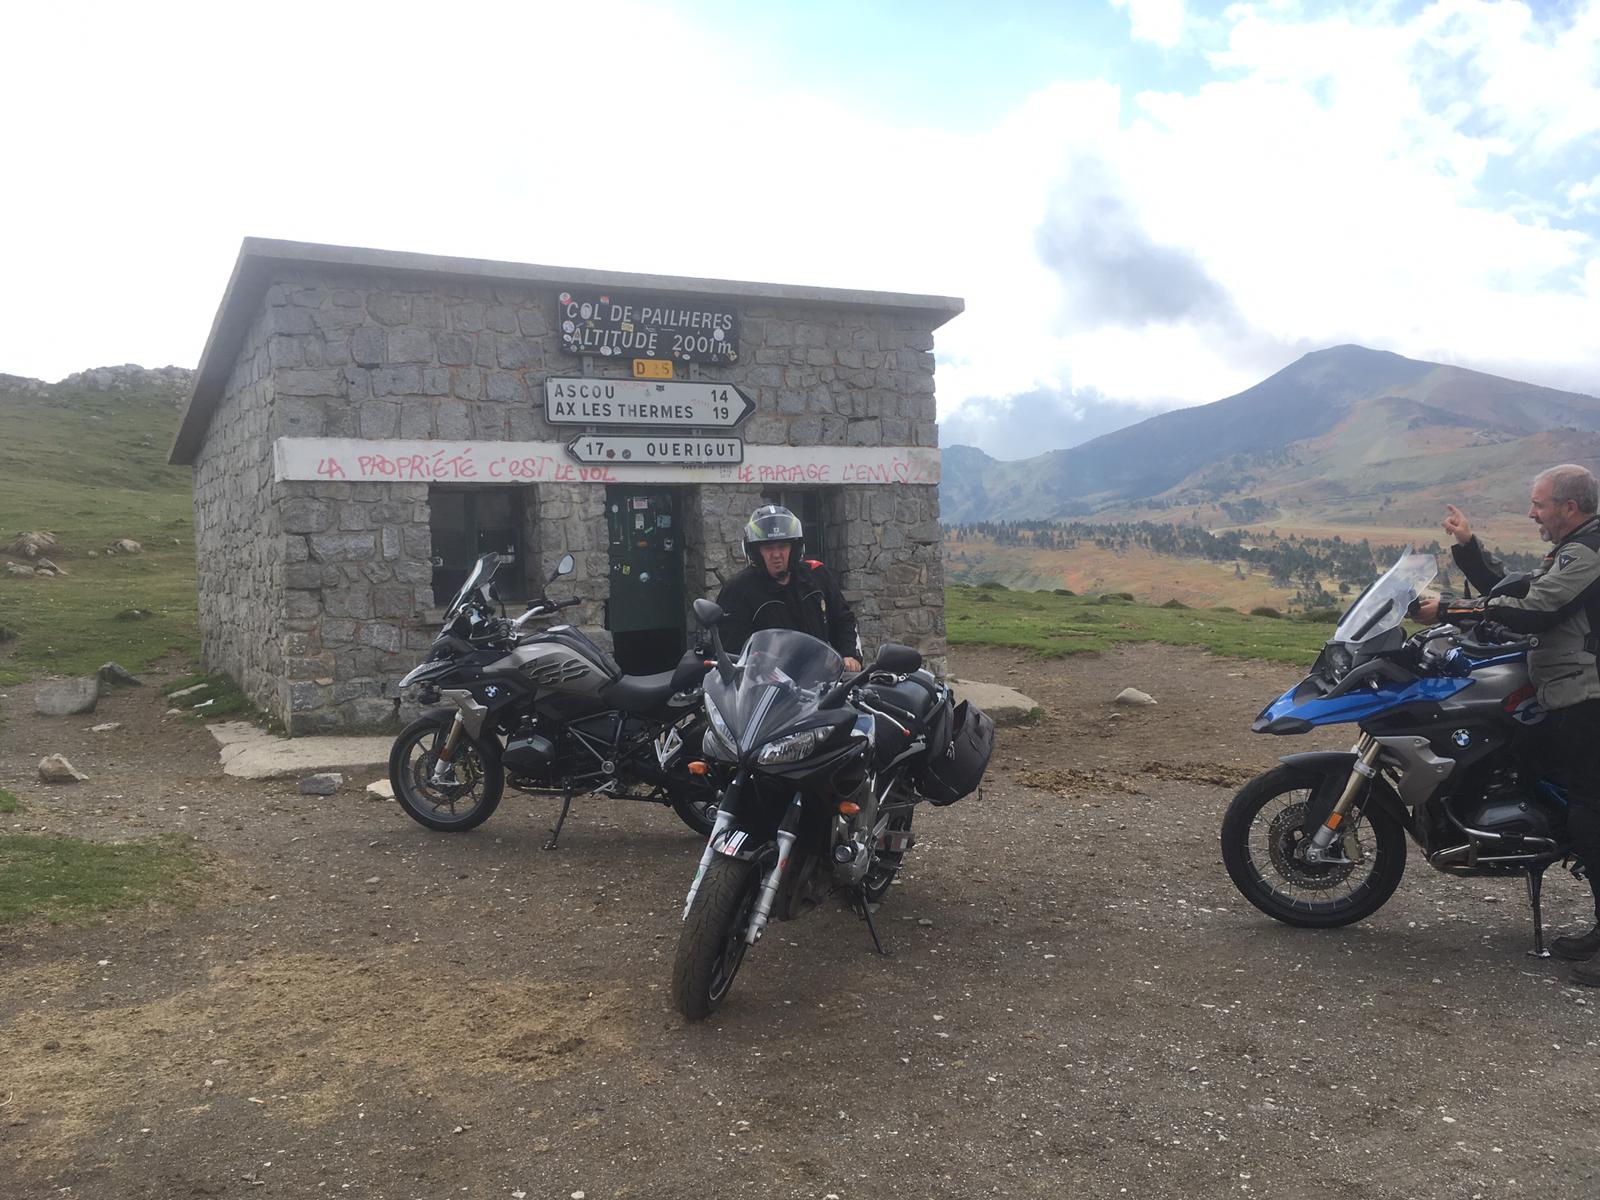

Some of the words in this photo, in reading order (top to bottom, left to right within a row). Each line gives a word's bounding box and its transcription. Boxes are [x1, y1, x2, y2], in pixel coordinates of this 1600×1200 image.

[567, 302, 601, 320] COL
[610, 305, 632, 322] DE
[641, 308, 732, 330] PAILHERES
[571, 328, 658, 350] ALTITUDE
[637, 362, 645, 375] D
[554, 384, 615, 399] ASCOU
[711, 389, 728, 402] 14
[555, 402, 576, 416] AX
[582, 403, 611, 416] LES
[618, 404, 693, 418] THERMES
[712, 406, 729, 419] 19
[586, 442, 604, 456] 17
[647, 443, 735, 456] QUERIGUT
[317, 457, 346, 479] LA
[555, 464, 576, 481] LE
[579, 466, 616, 482] VOL
[738, 464, 755, 483] LE
[758, 463, 830, 482] PARTAGE
